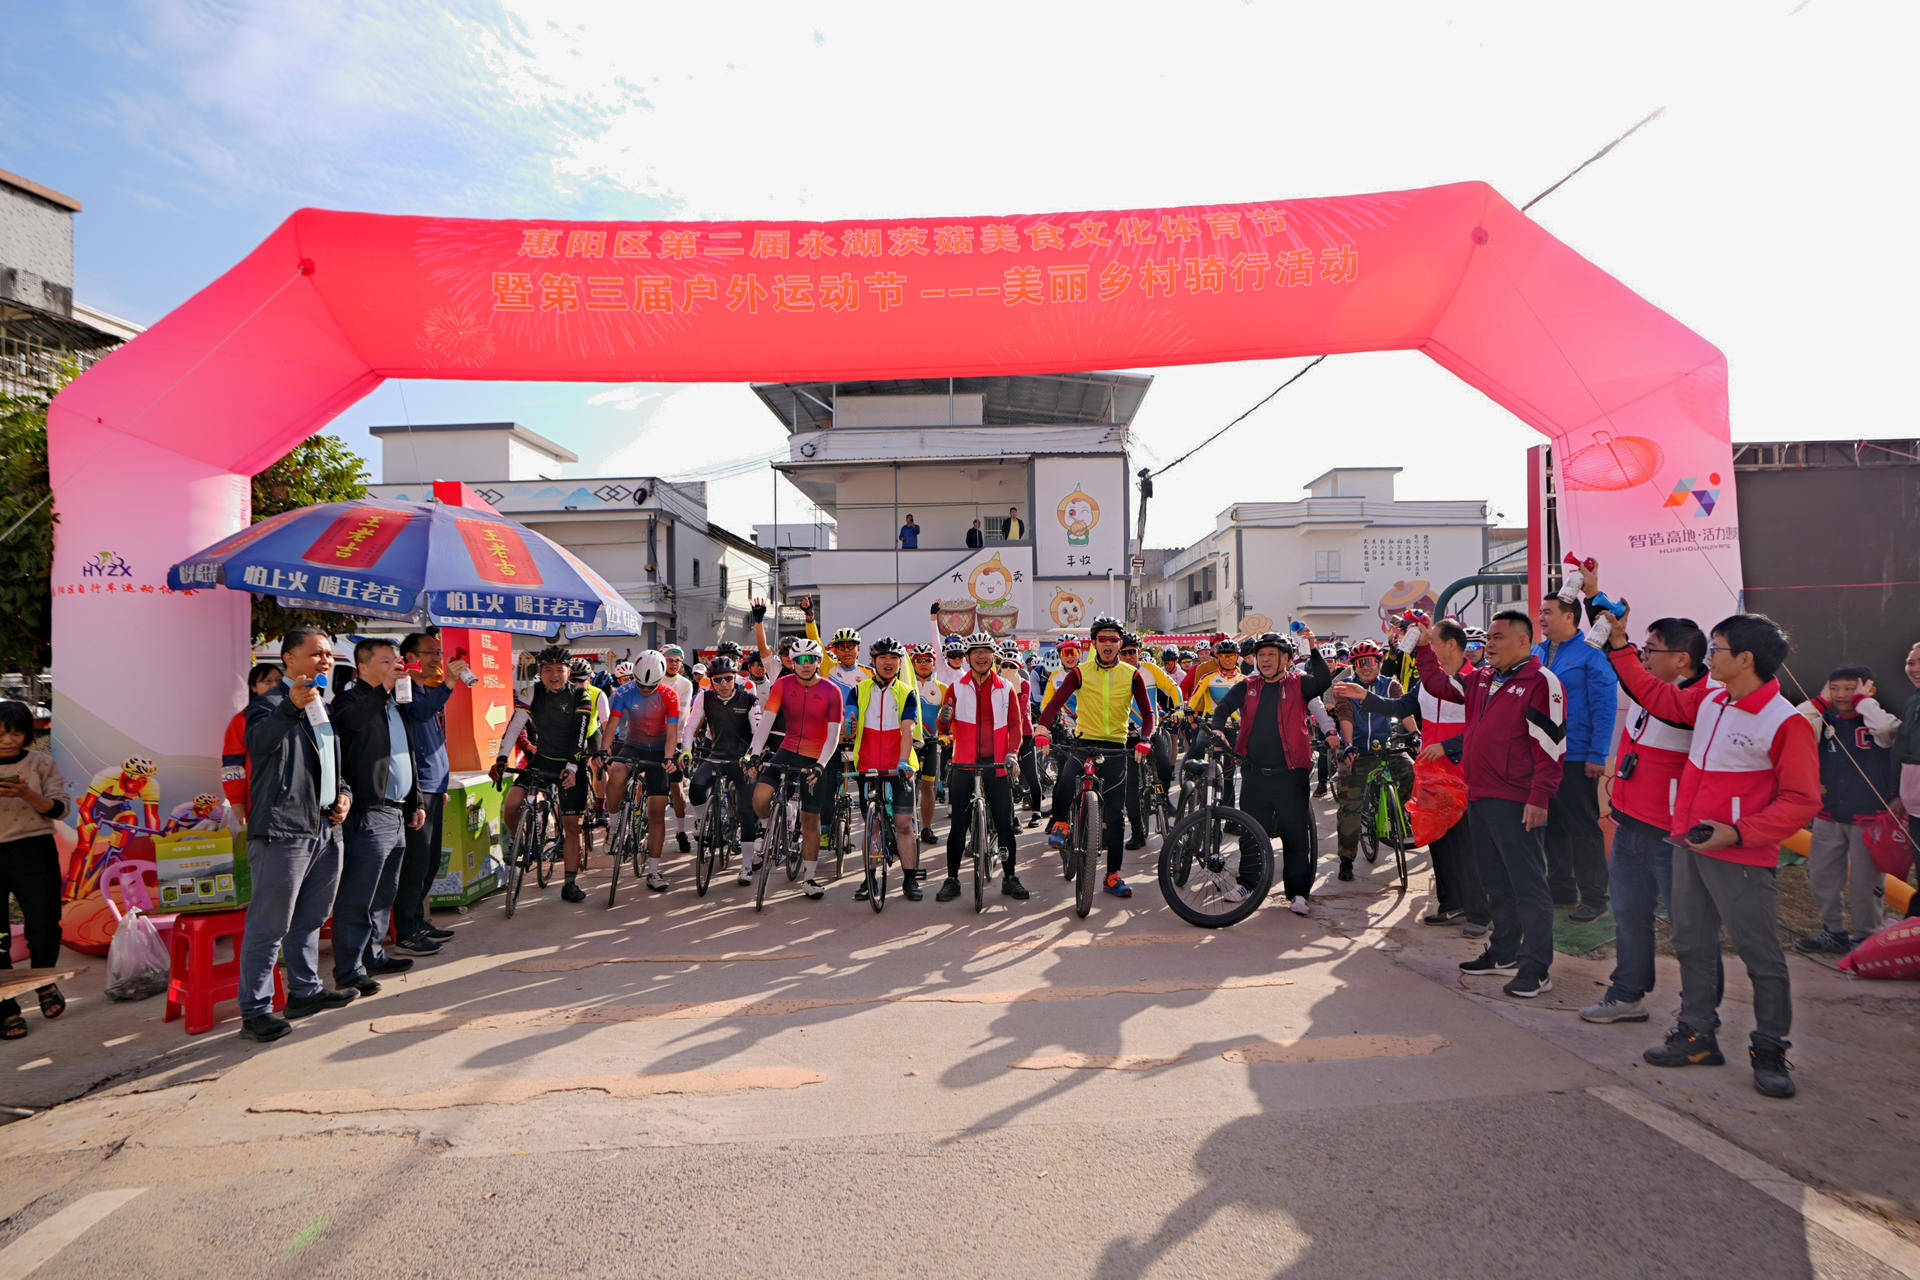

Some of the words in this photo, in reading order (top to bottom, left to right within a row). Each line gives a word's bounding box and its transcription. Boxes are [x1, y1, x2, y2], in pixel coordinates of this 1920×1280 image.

[517, 207, 1287, 261] 惠阳区第二届永湖茨菇美食文化体育节
[335, 515, 384, 559] 王老吉
[482, 528, 517, 577] 王老吉
[83, 565, 133, 577] HYZX
[1066, 553, 1092, 566] 丰收
[243, 565, 309, 593] 怕上火
[318, 575, 402, 606] 喝王老吉
[952, 571, 964, 583] 大
[446, 591, 504, 613] 怕上火
[514, 595, 585, 618] 喝王老吉
